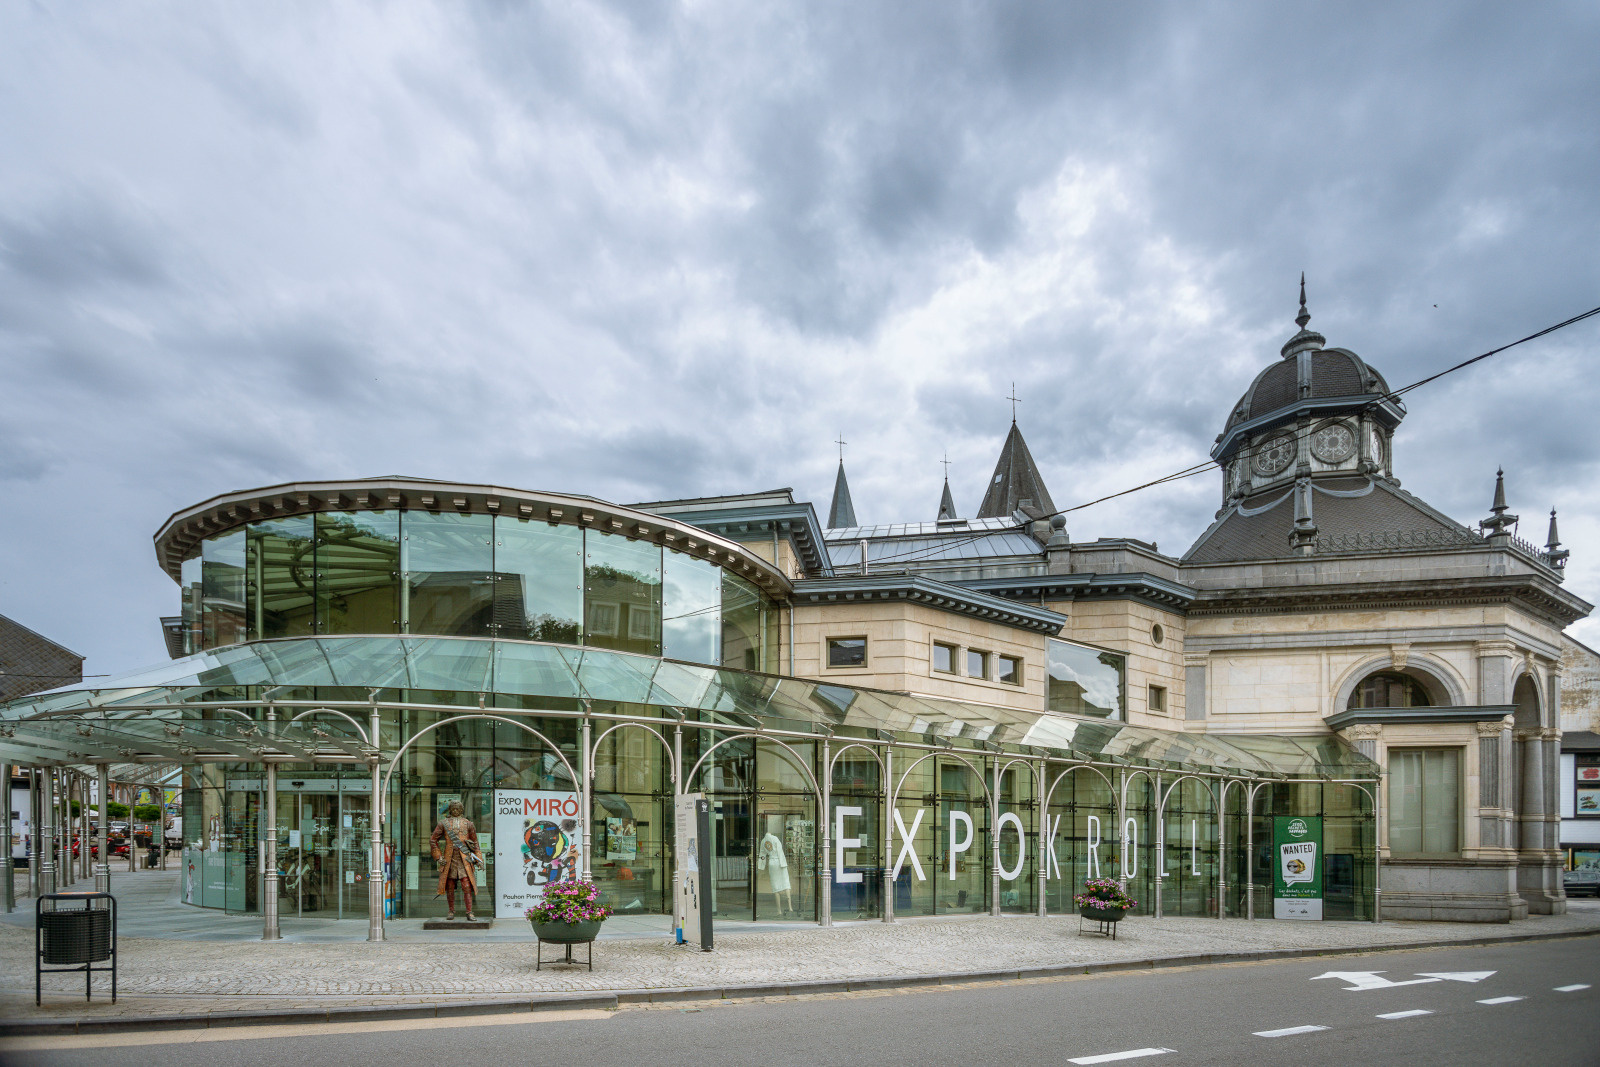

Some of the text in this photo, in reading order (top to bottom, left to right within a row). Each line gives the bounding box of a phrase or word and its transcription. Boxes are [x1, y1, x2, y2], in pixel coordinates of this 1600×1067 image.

[498, 797, 522, 806] EXPO
[524, 795, 579, 816] MIRÓ
[498, 807, 522, 815] JOAN
[1282, 843, 1313, 855] WANTED
